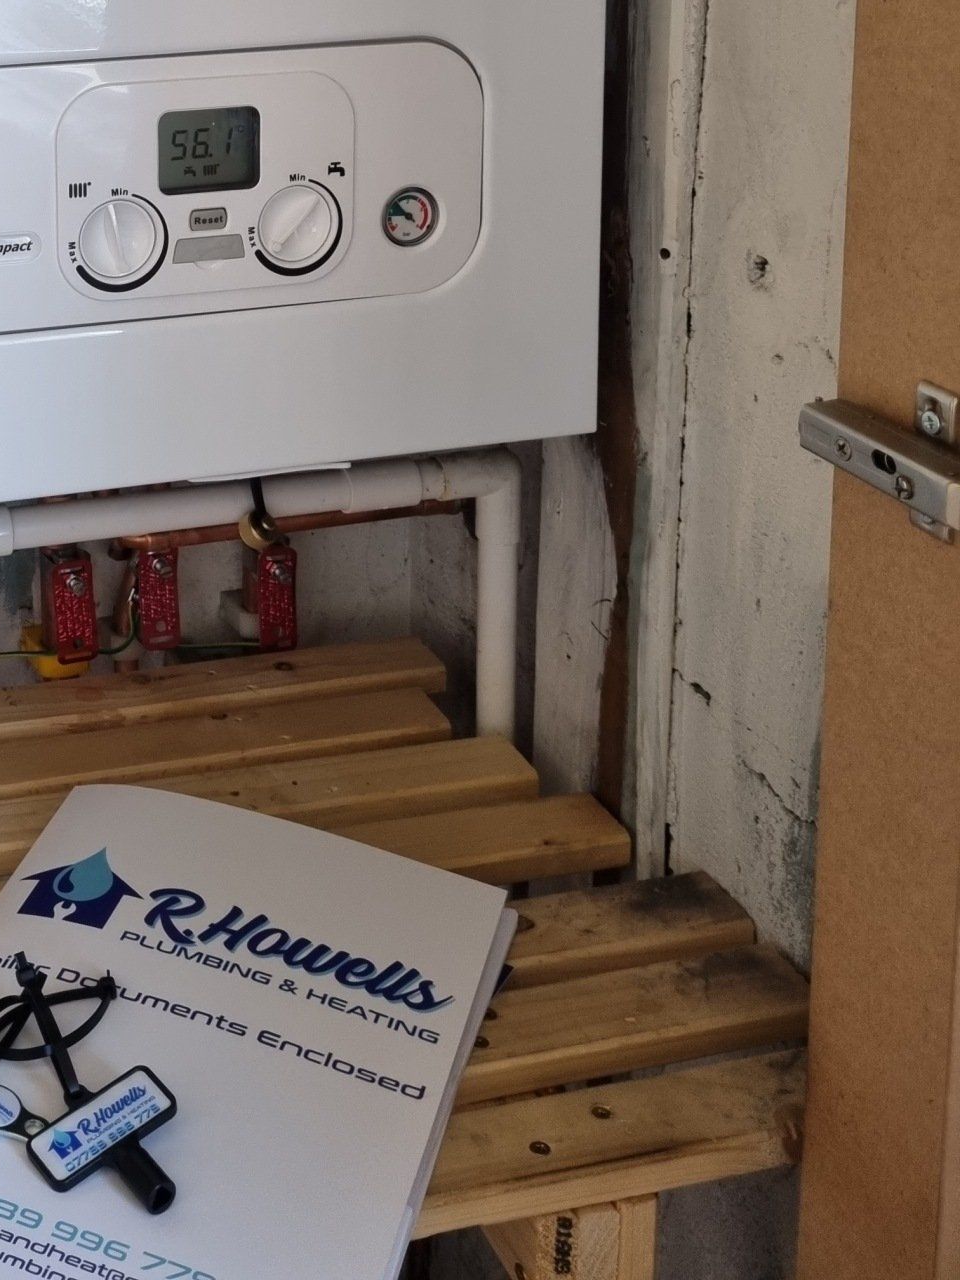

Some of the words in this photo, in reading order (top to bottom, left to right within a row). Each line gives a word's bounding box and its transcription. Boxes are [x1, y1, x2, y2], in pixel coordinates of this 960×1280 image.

[111, 187, 129, 197] Min
[289, 173, 306, 182] Min
[194, 215, 224, 225] Reset
[68, 241, 78, 264] Max
[247, 226, 256, 248] Max
[144, 887, 455, 1014] R.Howells
[119, 929, 273, 986] PLUMBING
[278, 978, 299, 996] &
[305, 988, 441, 1045] HEATING
[56, 967, 248, 1037] Douments
[256, 1029, 427, 1101] Enclosed
[77, 1084, 147, 1136] R.Howells
[51, 1219, 131, 1262] 996
